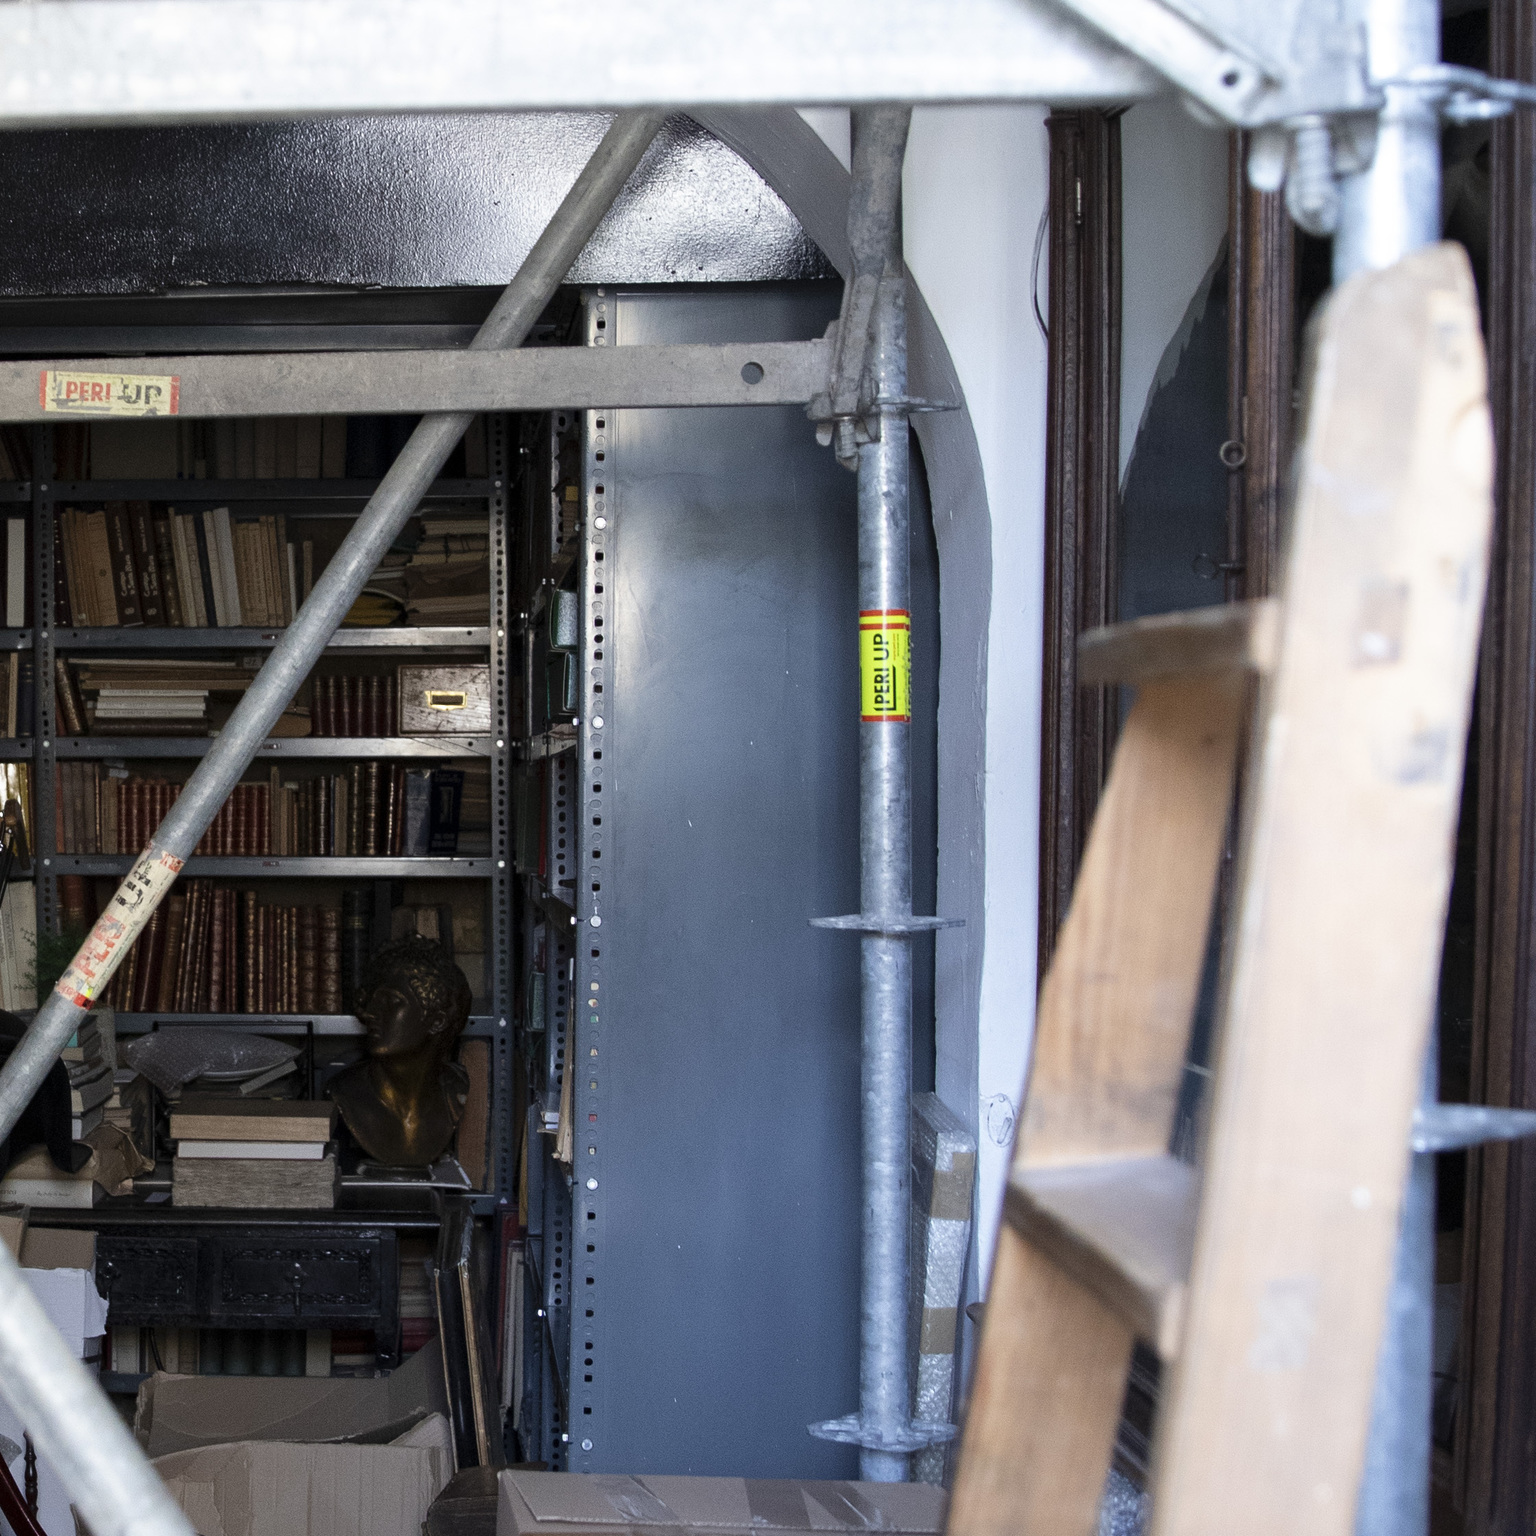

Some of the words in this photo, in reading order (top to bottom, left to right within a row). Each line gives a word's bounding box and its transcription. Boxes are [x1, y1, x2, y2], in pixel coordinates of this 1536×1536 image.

[64, 380, 112, 403] PERI
[122, 382, 162, 405] UP
[873, 633, 890, 662] UP
[873, 667, 890, 705] PERI
